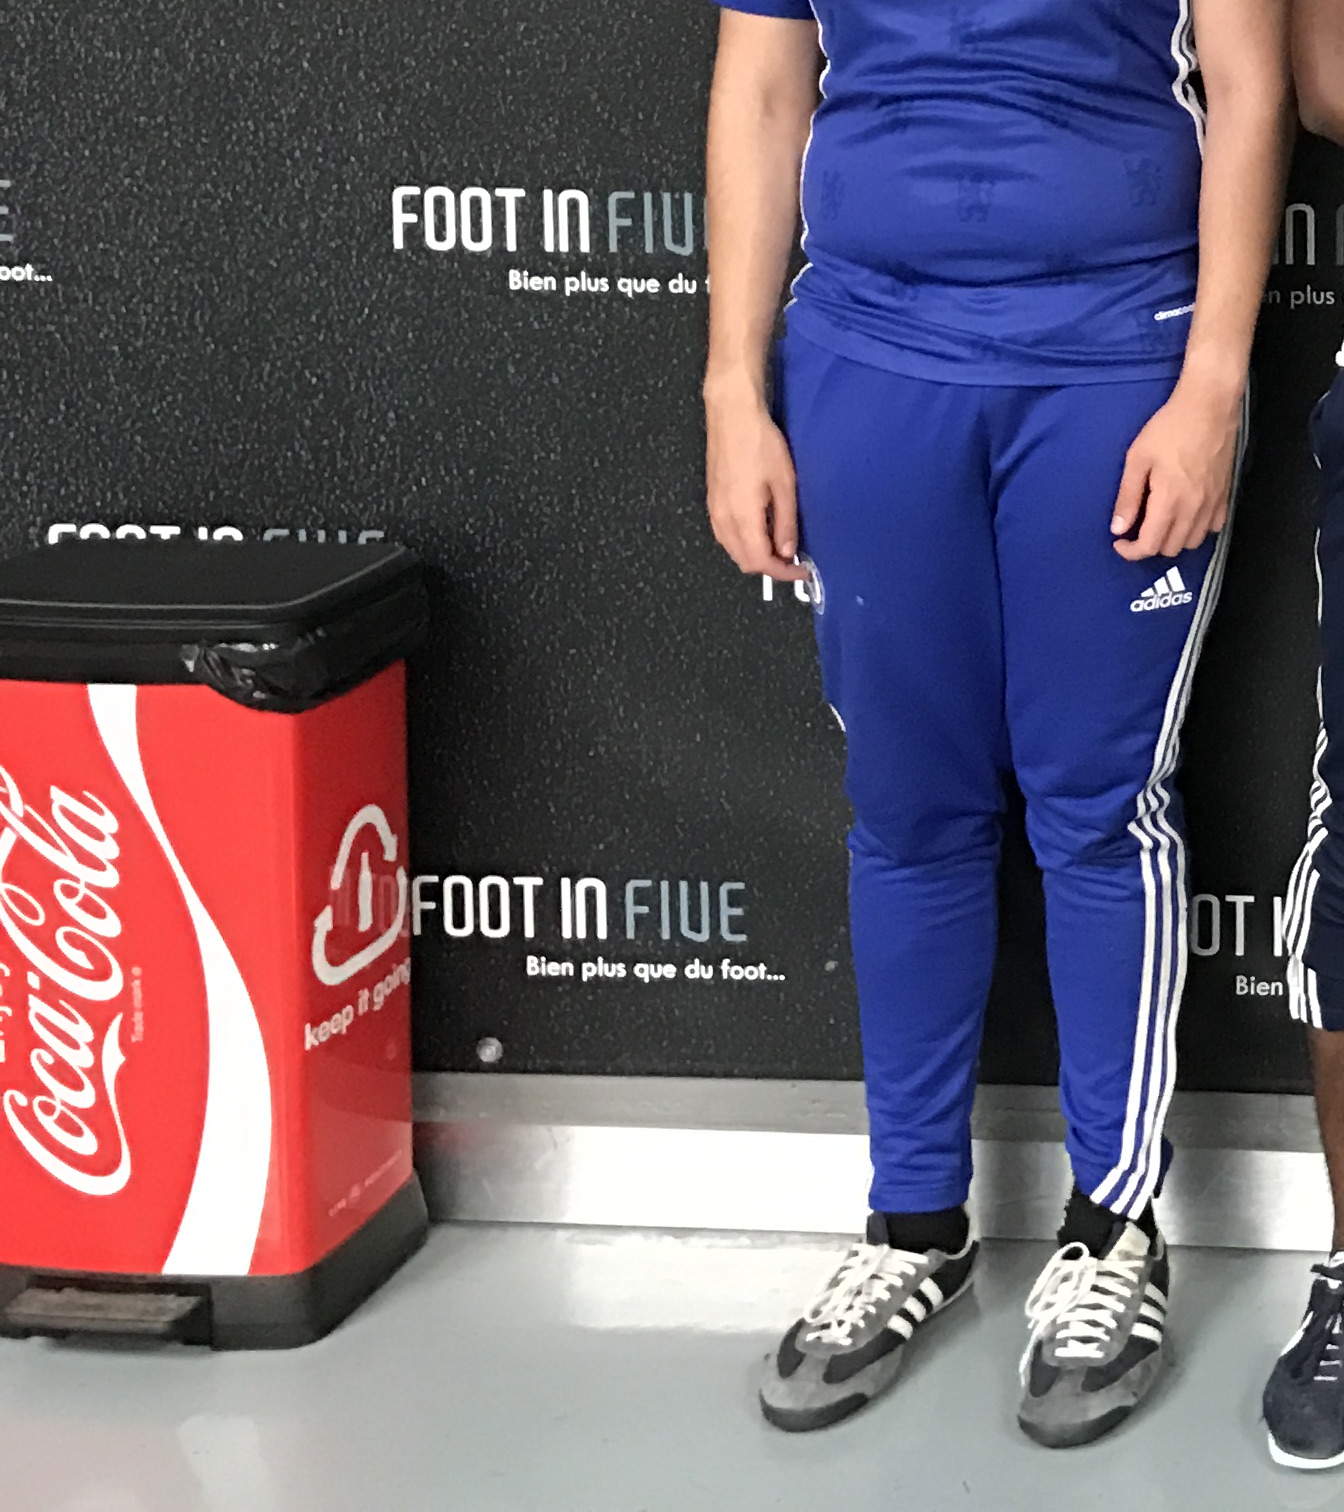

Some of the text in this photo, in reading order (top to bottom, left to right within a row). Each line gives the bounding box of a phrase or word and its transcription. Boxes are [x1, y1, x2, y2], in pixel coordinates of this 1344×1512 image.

[391, 186, 710, 257] FOOT IN FIV
[508, 269, 557, 291] Bien
[564, 270, 610, 297] plus
[617, 277, 660, 299] que
[668, 273, 697, 294] du
[1290, 284, 1334, 309] plus
[1130, 589, 1192, 612] adidas
[411, 875, 748, 943] FOOT IN FIVE
[525, 955, 786, 984] Bien plus que du foot...
[1235, 975, 1284, 997] Bien
[304, 1004, 355, 1051] keep
[357, 988, 370, 1017] it
